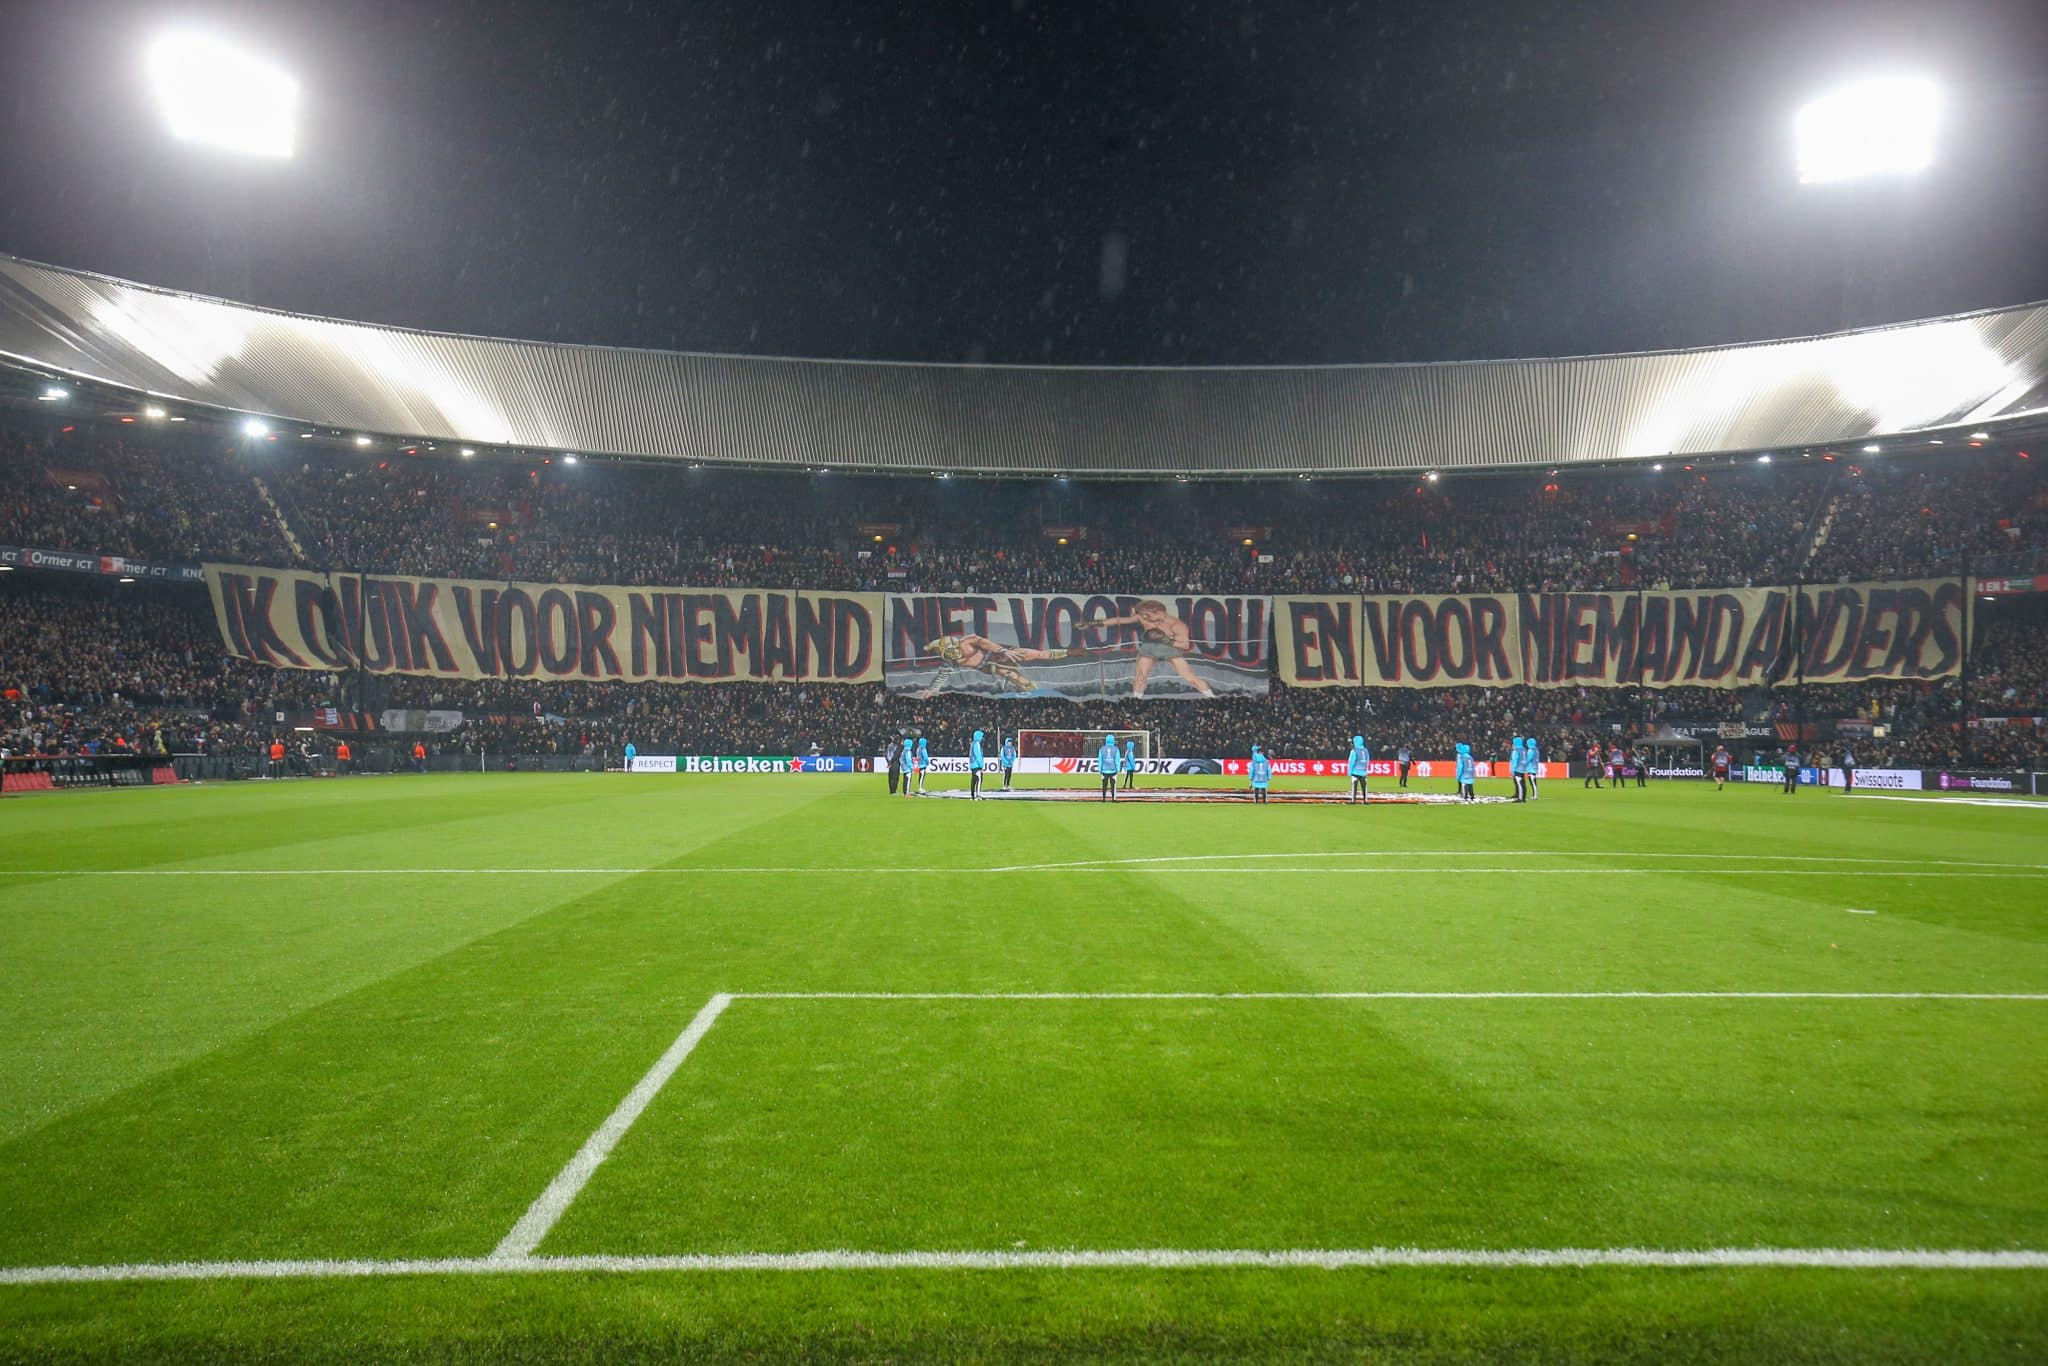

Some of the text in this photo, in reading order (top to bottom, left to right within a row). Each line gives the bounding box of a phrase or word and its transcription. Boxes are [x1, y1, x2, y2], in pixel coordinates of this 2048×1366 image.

[32, 552, 94, 569] Ormer ICT
[150, 567, 168, 576] ICT
[219, 571, 310, 668] IK
[452, 585, 624, 678] VOOR
[628, 592, 873, 679] NIEMAND
[1288, 582, 1962, 684] EN VOOR NIEMAND ANDERS
[1745, 727, 1771, 736] AGUE
[638, 760, 674, 768] RESPECT
[685, 757, 785, 773] Heineken
[1331, 761, 1391, 774] STUSS
[1649, 767, 1703, 776] Foundation
[1747, 766, 1786, 784] Heineke
[1854, 770, 1904, 788] Swissquote
